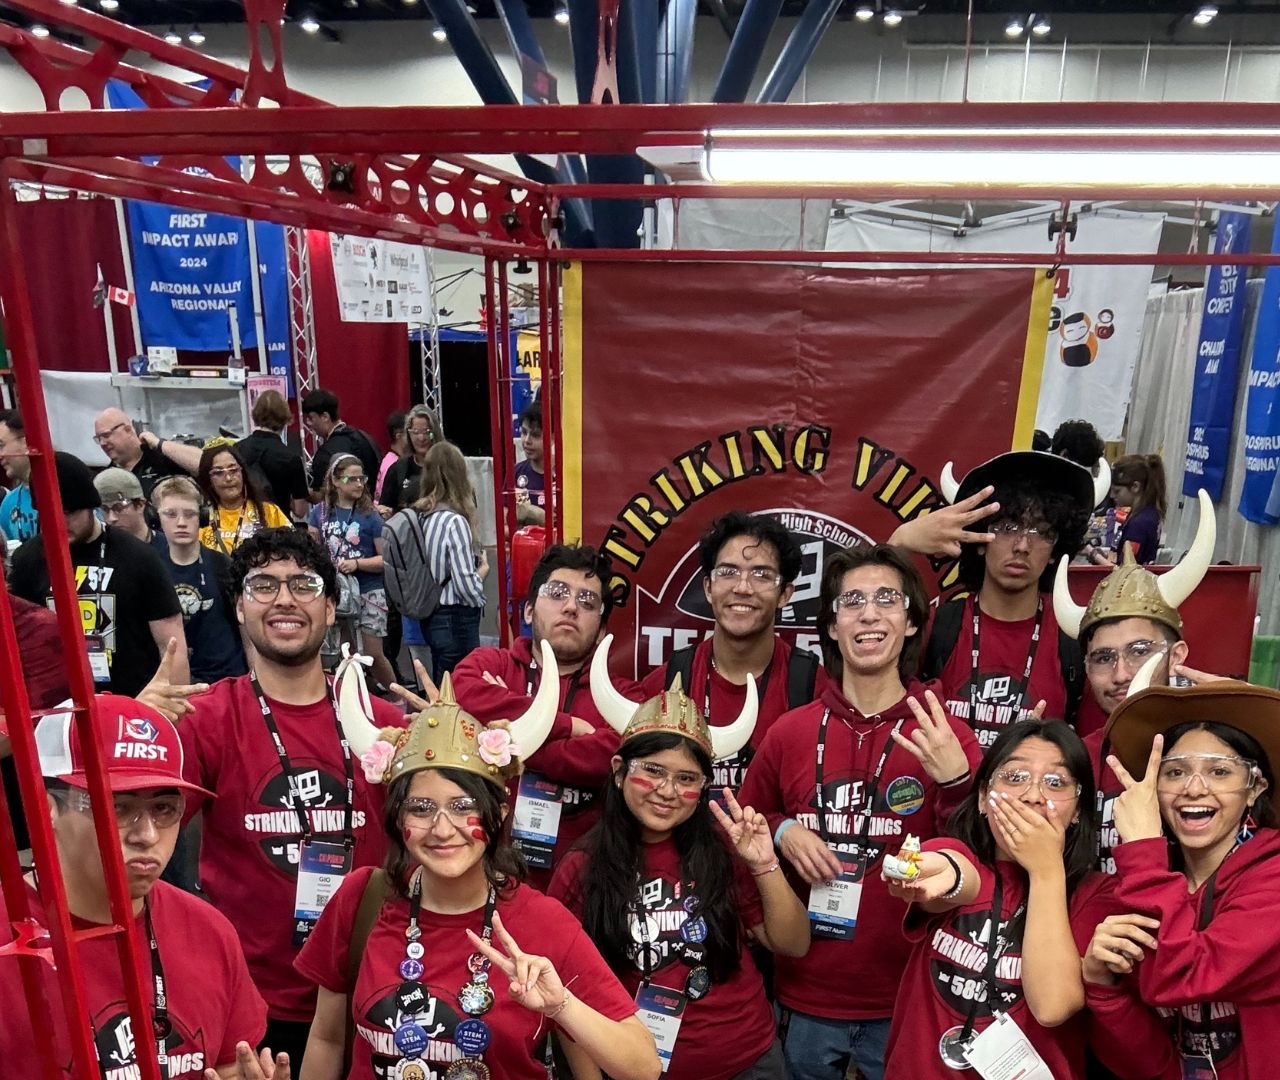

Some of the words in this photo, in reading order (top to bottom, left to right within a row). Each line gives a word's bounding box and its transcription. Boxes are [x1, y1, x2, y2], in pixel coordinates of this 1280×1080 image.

[169, 213, 208, 228] FIRST
[179, 258, 208, 268] 2024
[150, 280, 201, 295] ARIZONA
[203, 280, 243, 294] VALLEY
[604, 423, 832, 608] STRIKING
[780, 513, 812, 531] High
[114, 742, 168, 761] FIRST
[529, 799, 550, 809] ISMAEL
[245, 810, 311, 833] STRIKIN
[311, 810, 366, 833] VIKIGS
[318, 876, 331, 884] GIO
[825, 881, 849, 891] OLIVER
[931, 928, 989, 974] STRIKING
[950, 975, 988, 1003] 585
[646, 1013, 666, 1023] SOFIA
[401, 1036, 422, 1045] STEM
[463, 1030, 482, 1039] STEM
